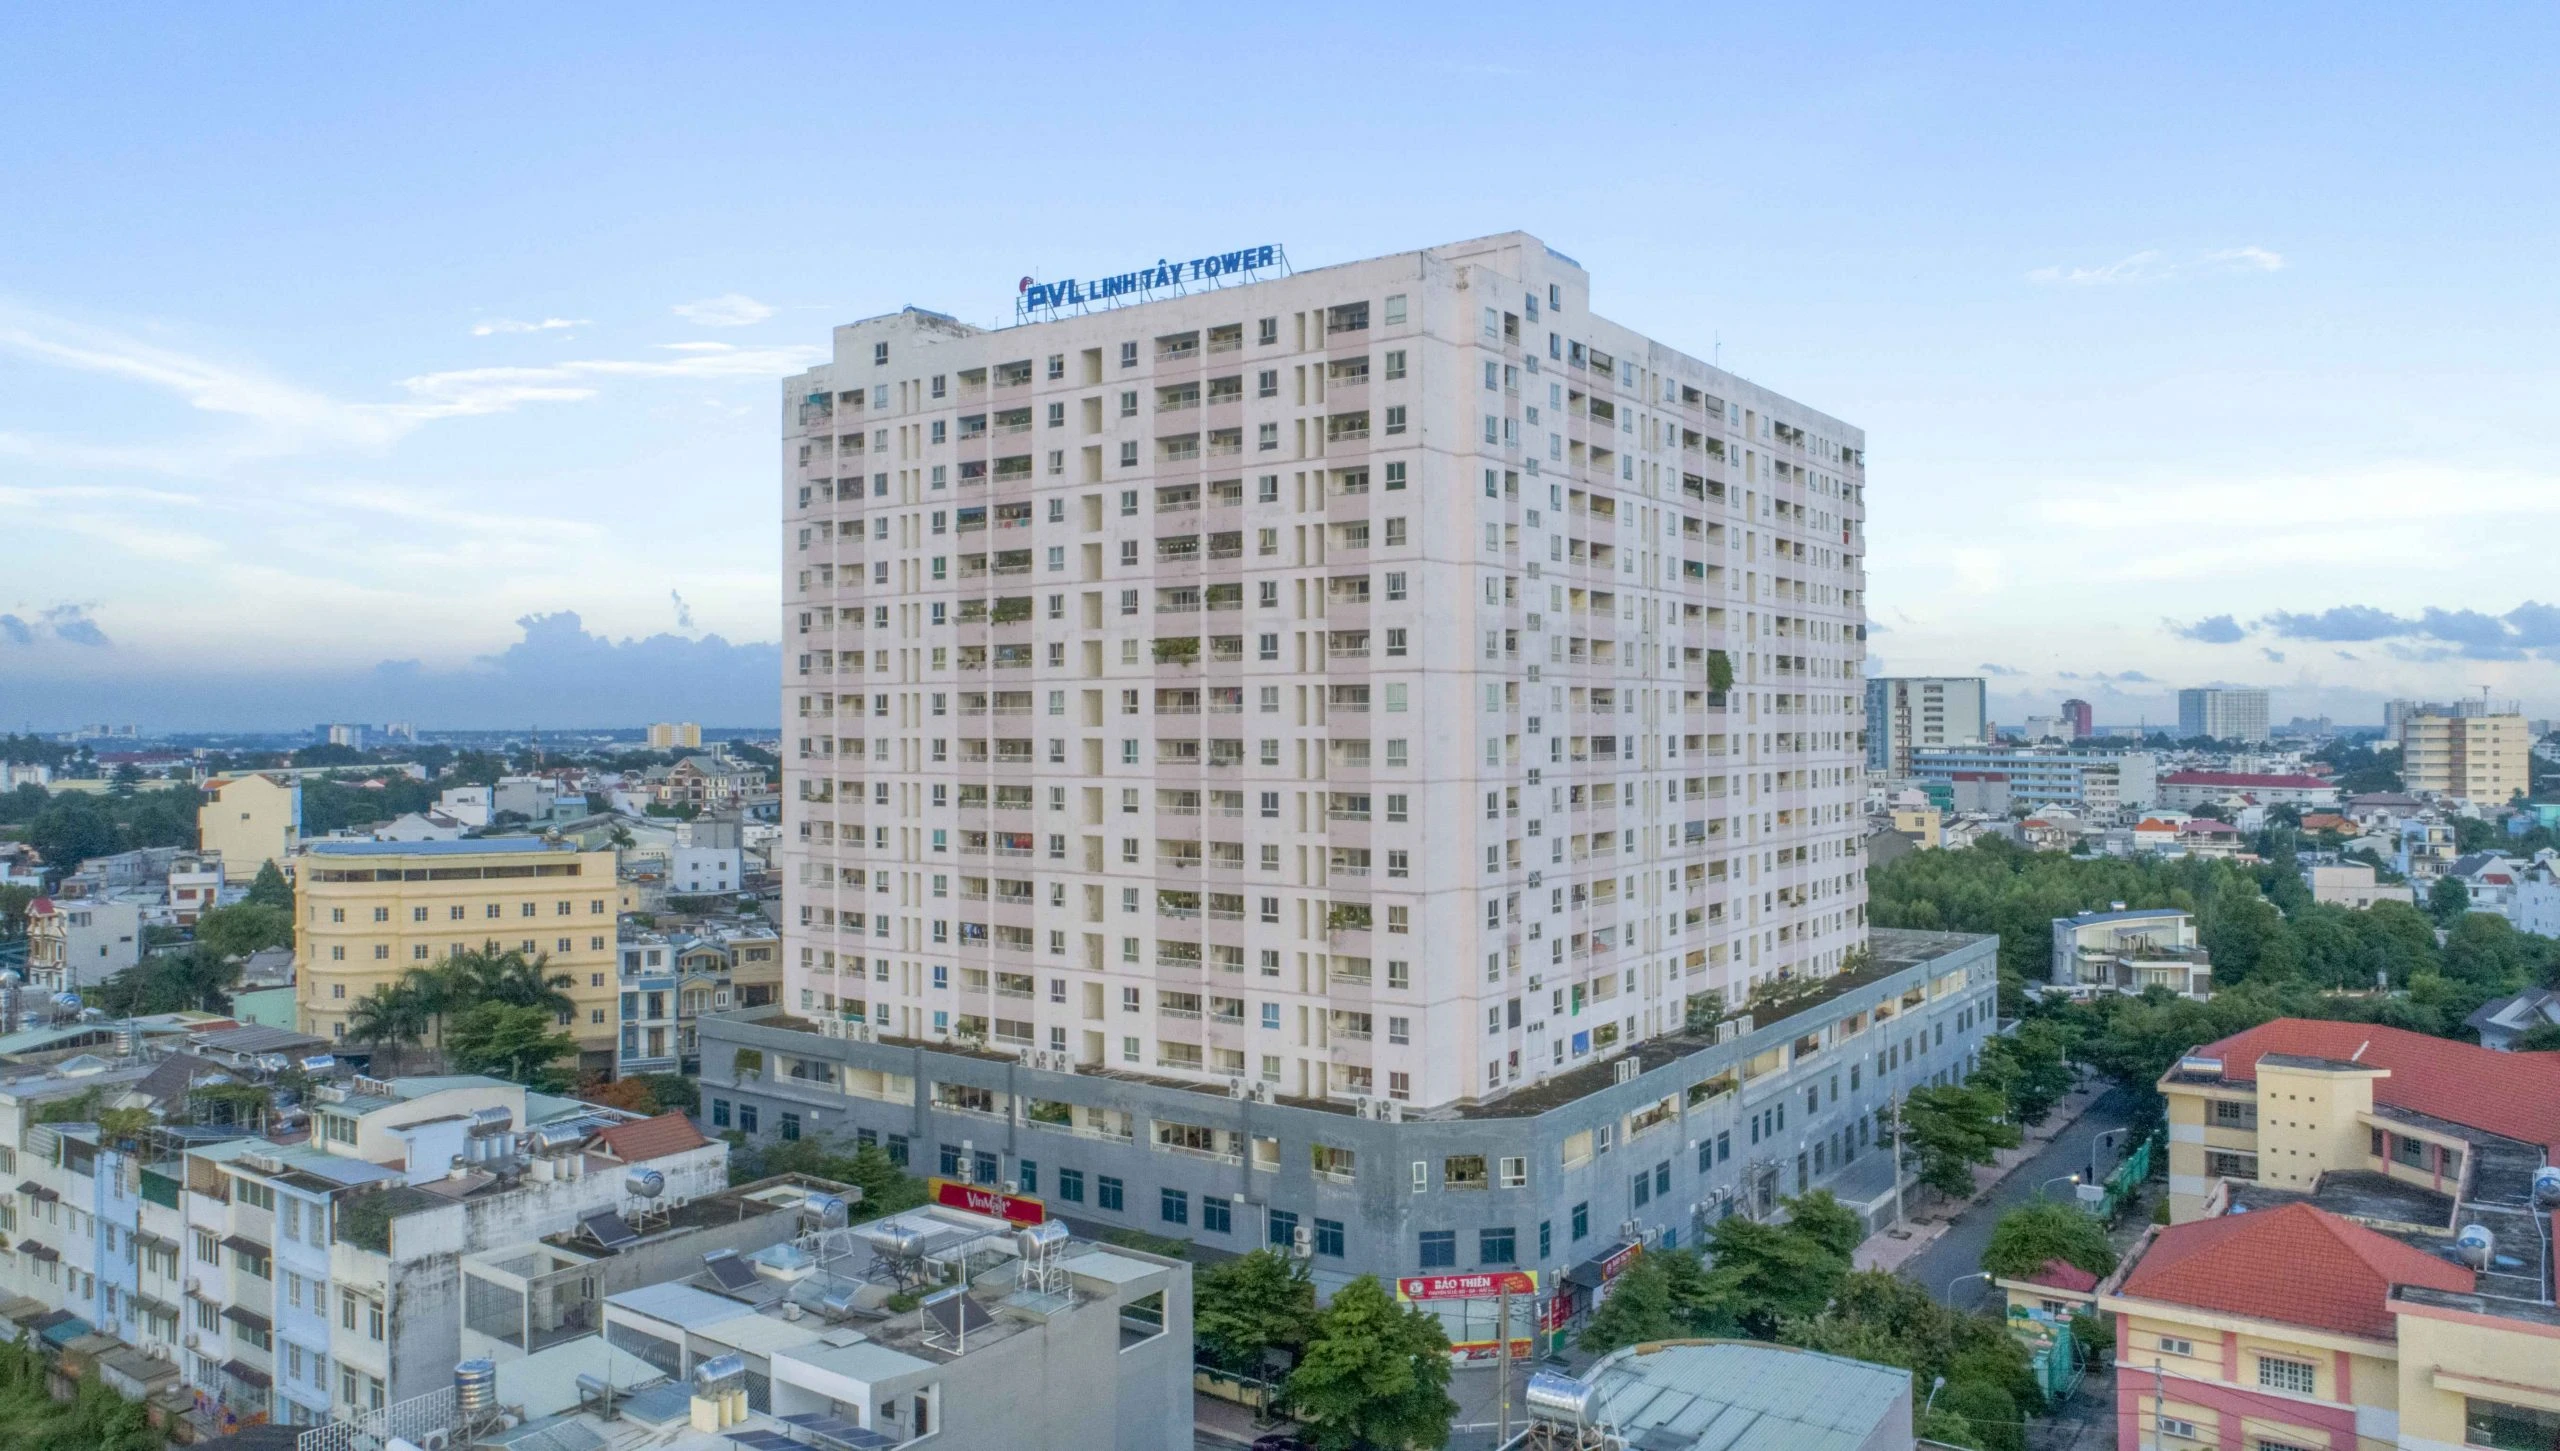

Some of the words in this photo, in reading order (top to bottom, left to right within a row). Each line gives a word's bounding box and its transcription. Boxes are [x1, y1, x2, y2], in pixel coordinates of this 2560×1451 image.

[1027, 279, 1085, 313] PVL
[1089, 273, 1137, 301] LINH
[1141, 258, 1184, 289] TÂY
[1190, 245, 1274, 280] TOWER
[1434, 1276, 1458, 1290] BẢO
